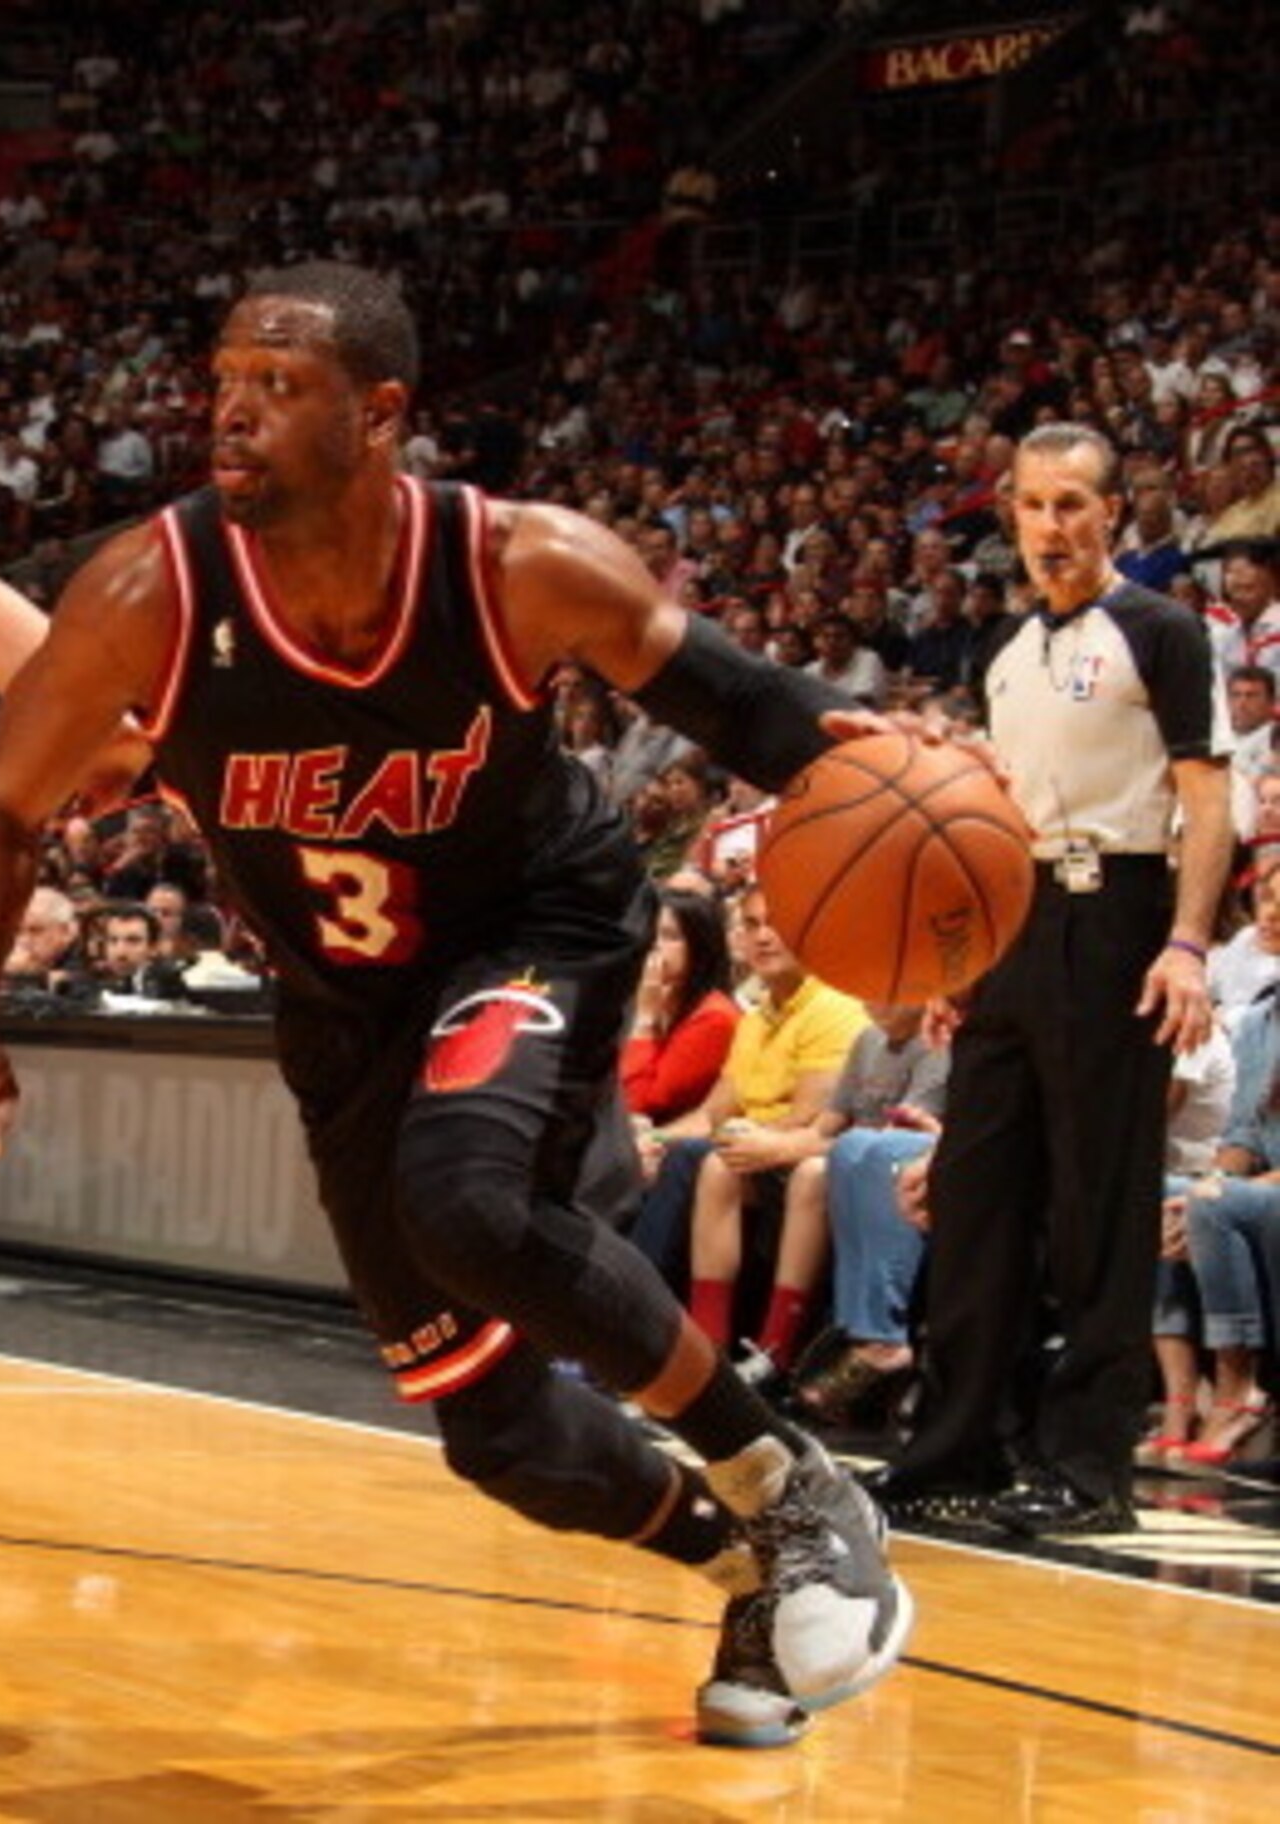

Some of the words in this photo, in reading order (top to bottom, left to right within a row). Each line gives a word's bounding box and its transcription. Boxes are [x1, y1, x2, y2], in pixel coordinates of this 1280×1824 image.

[884, 28, 1063, 88] BACAR
[220, 704, 492, 840] HEAT
[296, 846, 404, 960] 3
[99, 1072, 297, 1262] RADIO
